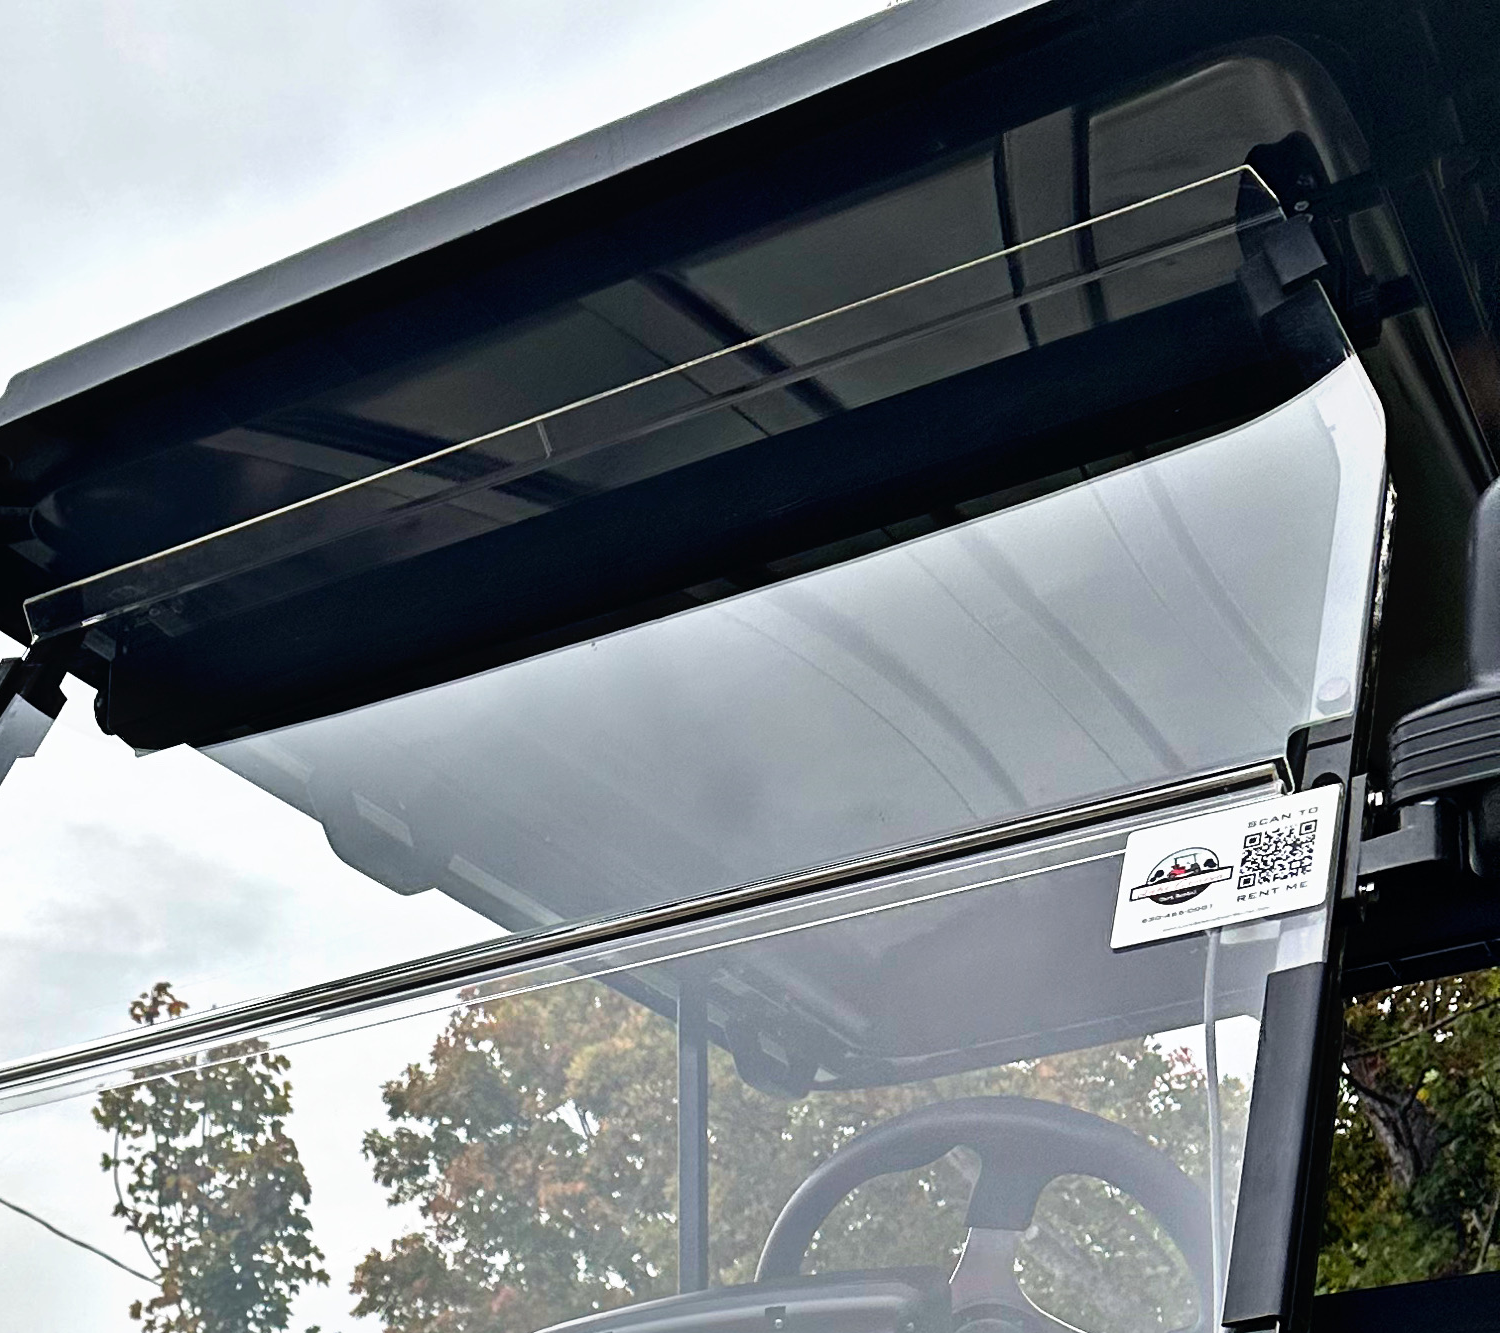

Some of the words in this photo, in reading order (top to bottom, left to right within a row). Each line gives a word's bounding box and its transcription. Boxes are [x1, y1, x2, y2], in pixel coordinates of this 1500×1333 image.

[1247, 812, 1291, 828] SCAN
[1300, 806, 1319, 818] TO
[1236, 887, 1278, 902] RENT
[1285, 881, 1309, 892] ME
